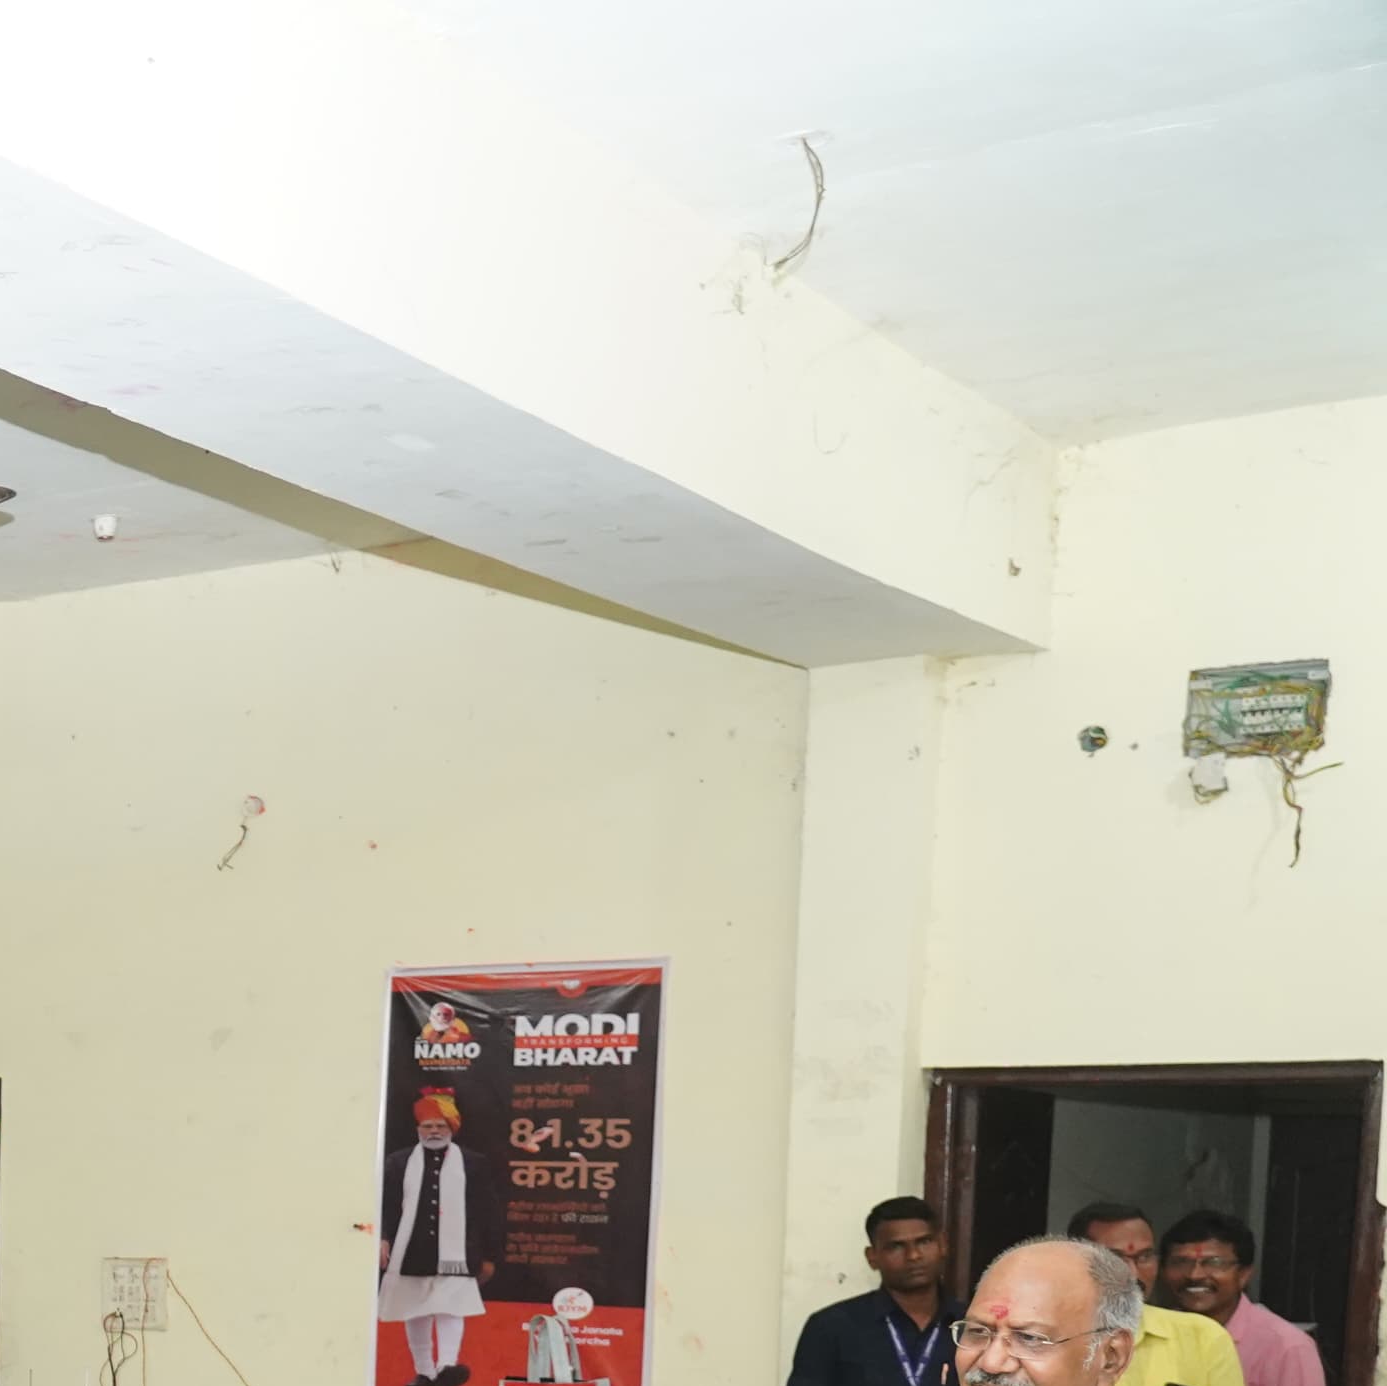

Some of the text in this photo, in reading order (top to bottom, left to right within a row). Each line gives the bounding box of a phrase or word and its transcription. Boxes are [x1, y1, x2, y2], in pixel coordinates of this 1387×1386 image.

[515, 1013, 640, 1037] MODI
[414, 1042, 481, 1060] NAMO
[521, 1036, 629, 1047] TRANSFORMING
[513, 1047, 639, 1067] BHARAT
[509, 1118, 633, 1150] 81.35
[508, 1151, 619, 1199] करोड़
